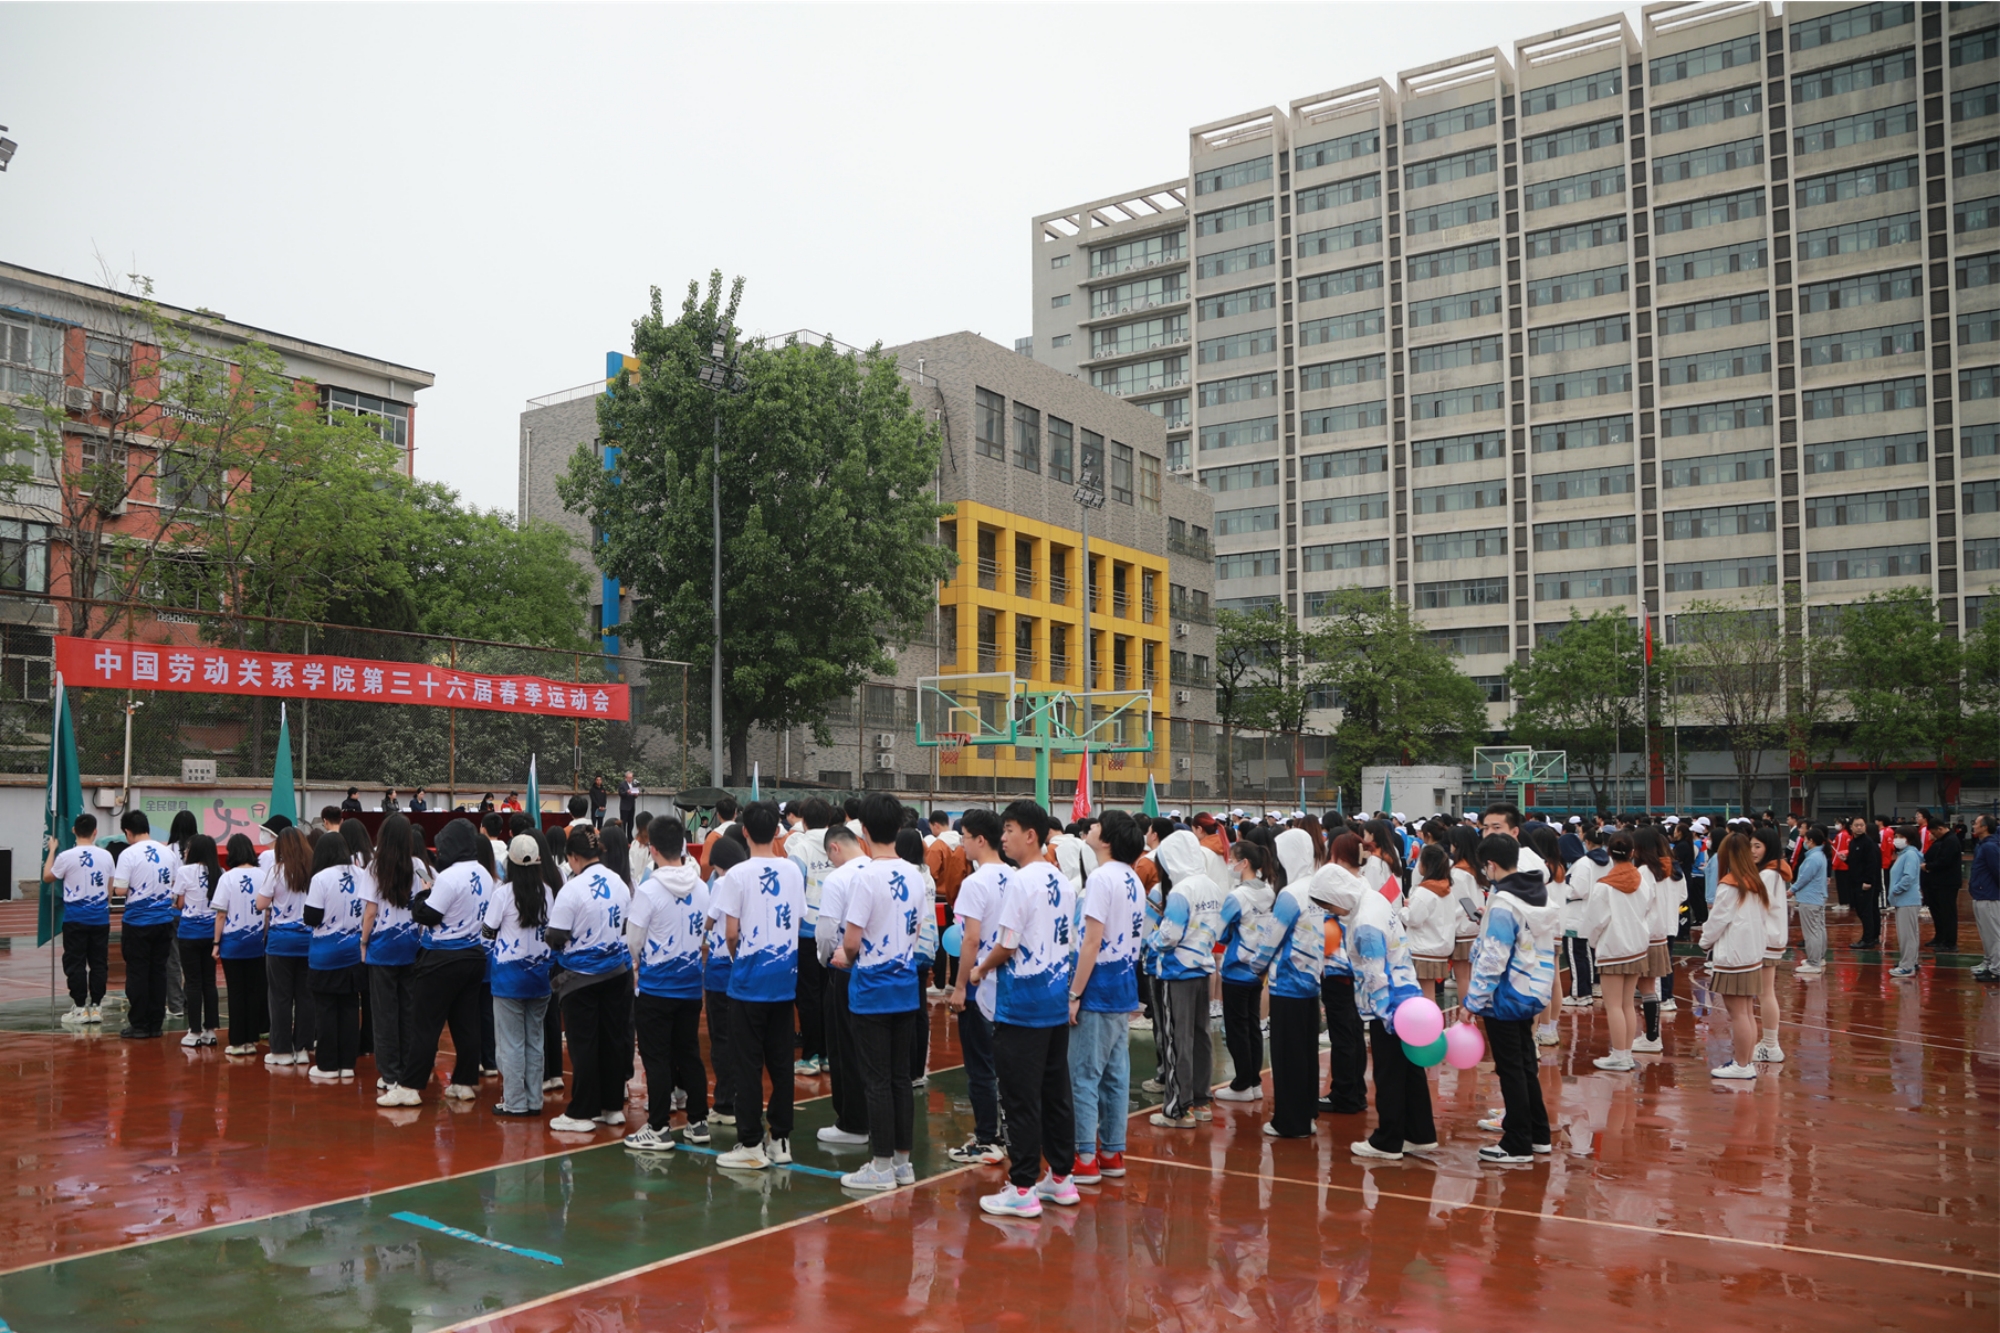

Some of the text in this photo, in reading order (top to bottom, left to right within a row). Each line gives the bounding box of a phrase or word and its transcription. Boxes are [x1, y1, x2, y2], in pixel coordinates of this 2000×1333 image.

[94, 647, 610, 713] 中国劳动关系学院第三十六届春季运动会
[146, 801, 188, 811] 全民健身
